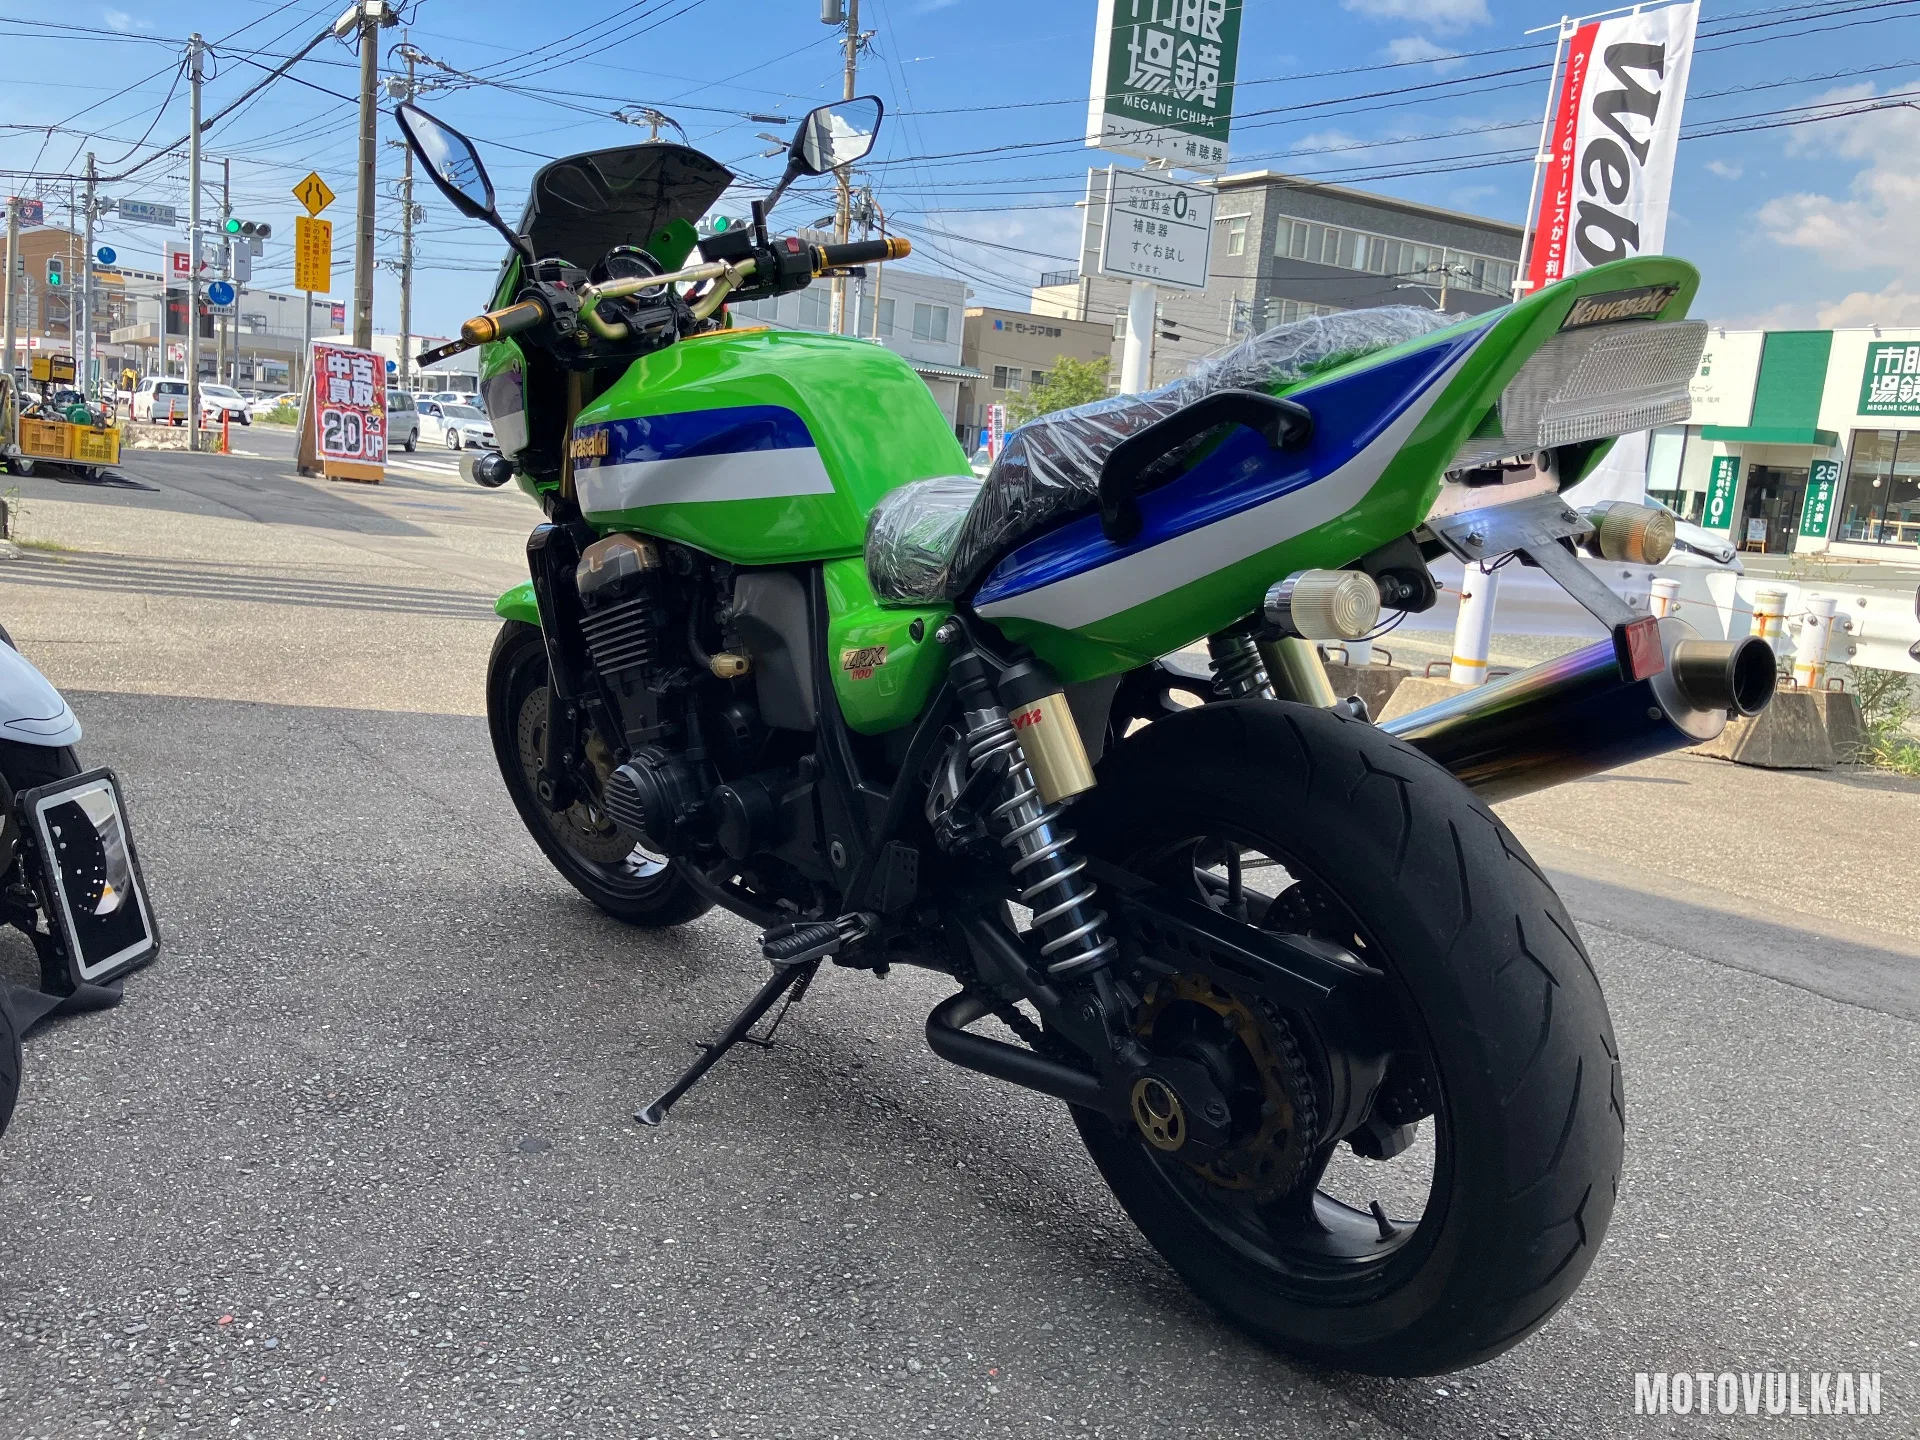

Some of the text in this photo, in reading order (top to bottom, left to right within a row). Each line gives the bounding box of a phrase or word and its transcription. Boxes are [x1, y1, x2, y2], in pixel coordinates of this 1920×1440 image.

[1122, 95, 1215, 128] MEGANE ICHIBA
[1133, 217, 1168, 238] 補聴器
[1131, 240, 1185, 263] すぐお試し
[1563, 287, 1680, 327] Kawasaki
[327, 353, 374, 384] 中古
[328, 377, 375, 408] 買取
[1899, 404, 1920, 412] ICHIB
[843, 646, 885, 671] ZRX
